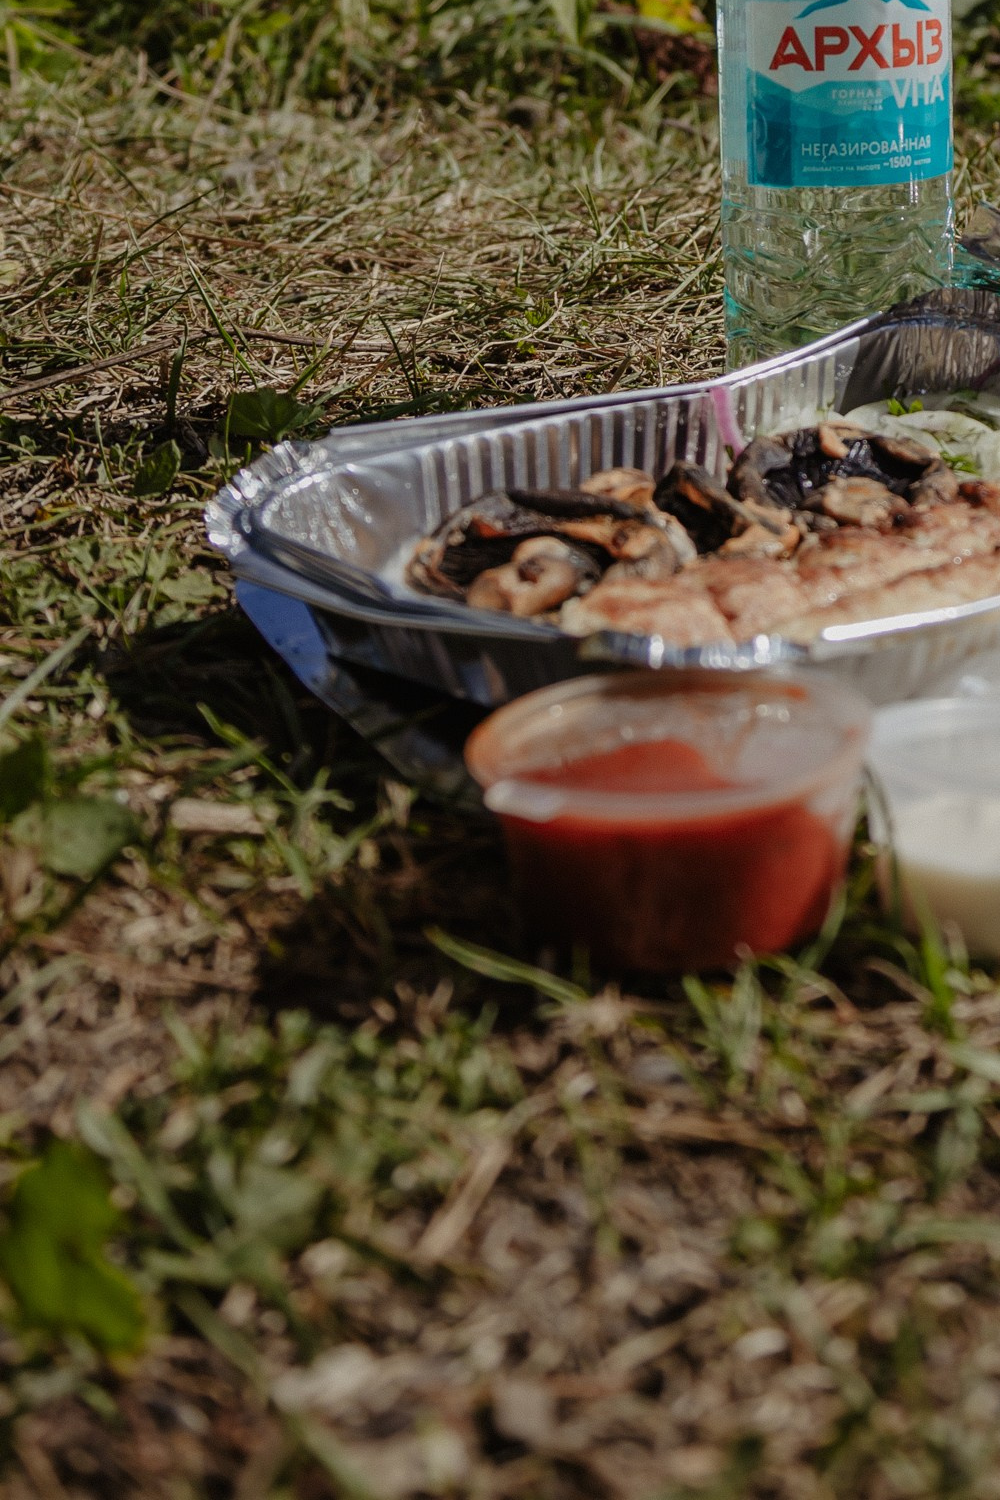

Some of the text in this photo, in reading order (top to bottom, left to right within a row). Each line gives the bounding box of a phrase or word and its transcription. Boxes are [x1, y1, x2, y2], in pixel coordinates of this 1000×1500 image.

[769, 18, 943, 71] АРХЫЗ
[889, 75, 944, 109] VITA
[801, 134, 931, 157] НЕГАЗИРОВАННАЯ
